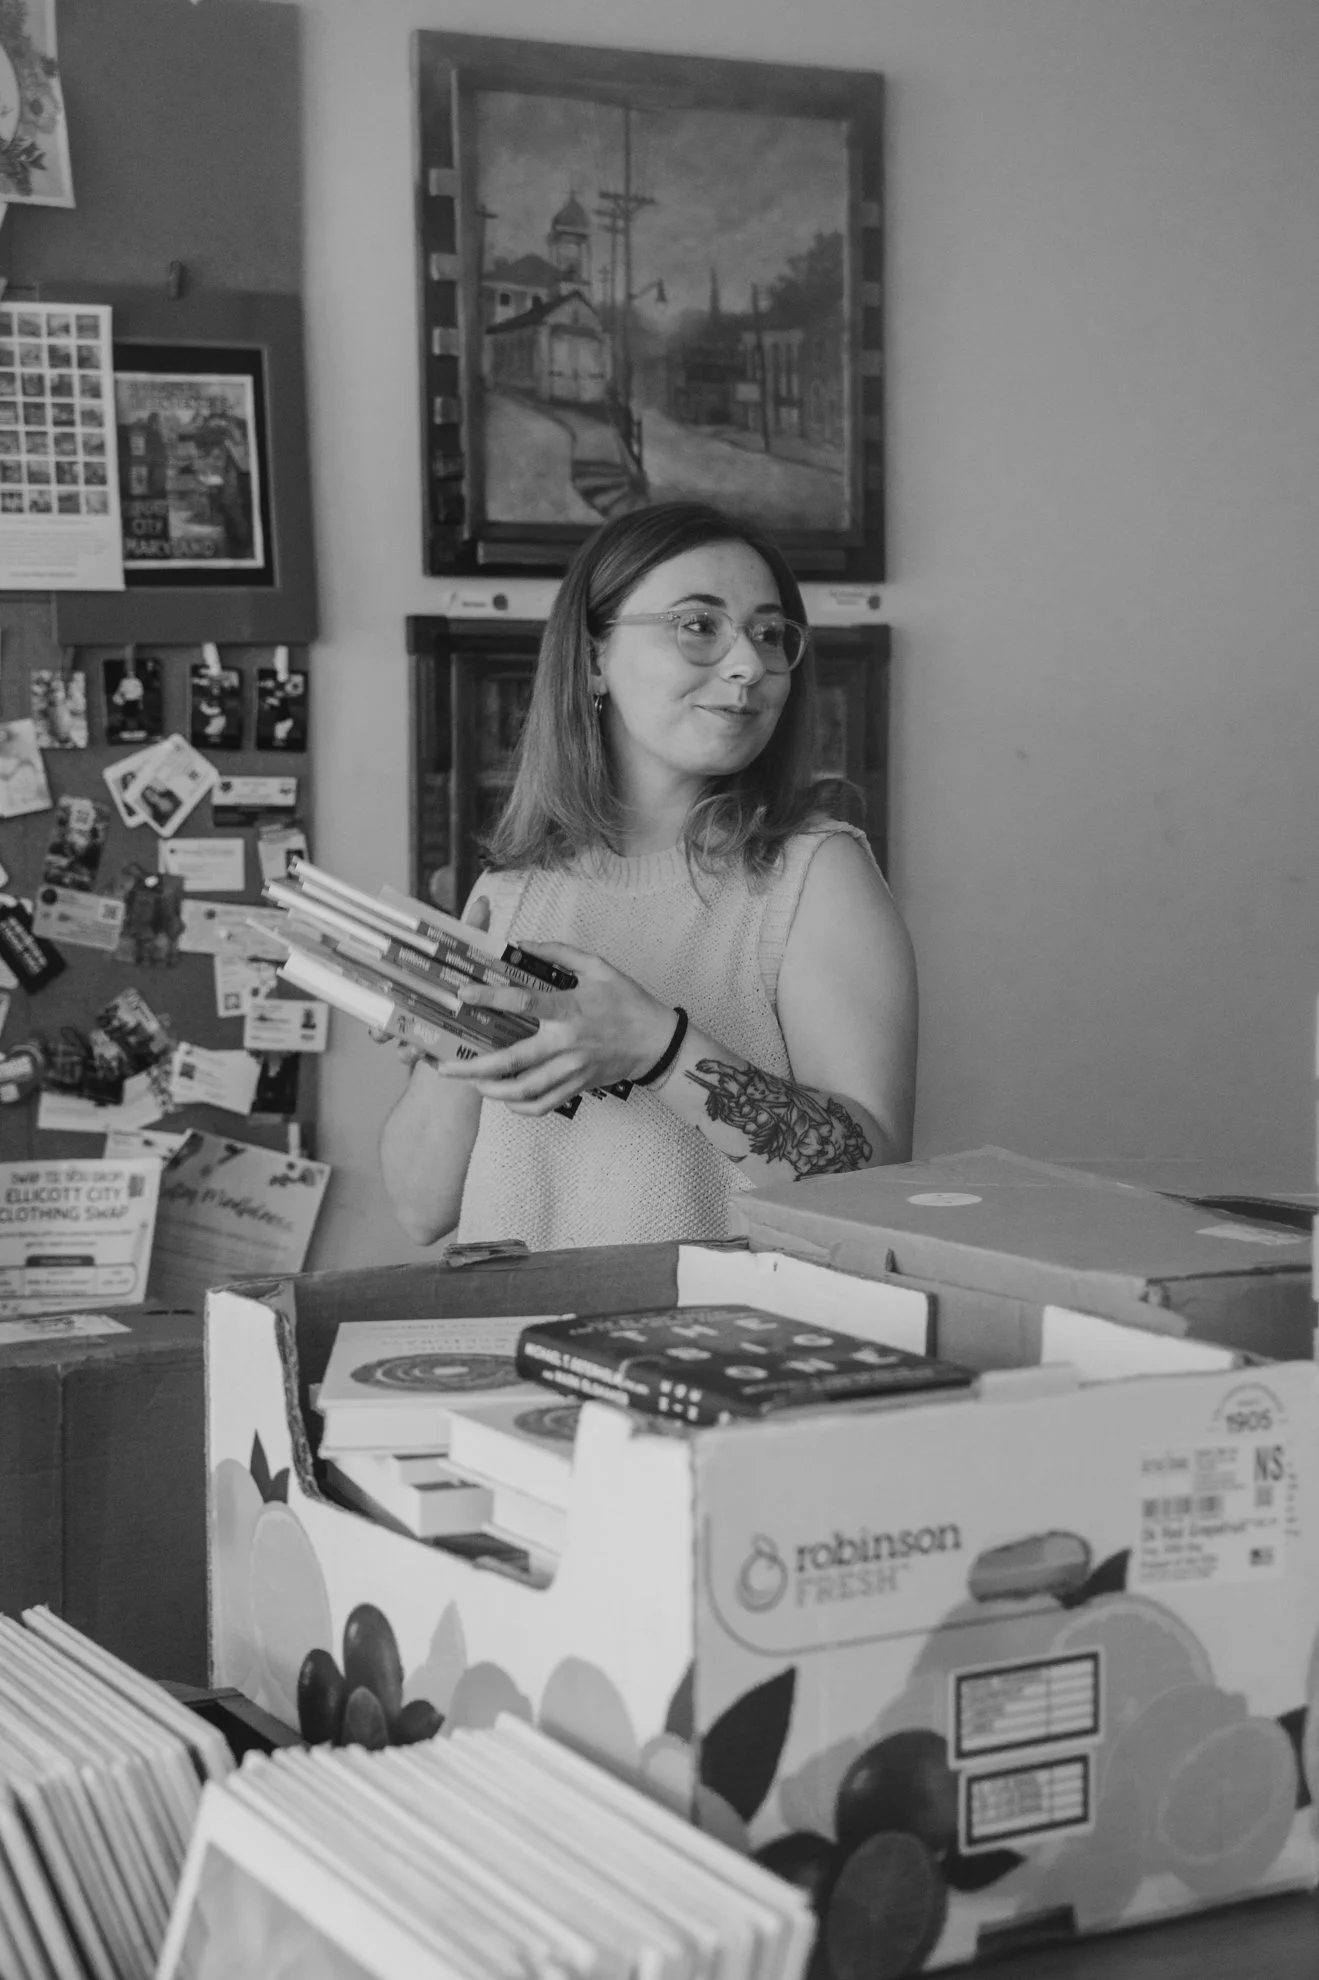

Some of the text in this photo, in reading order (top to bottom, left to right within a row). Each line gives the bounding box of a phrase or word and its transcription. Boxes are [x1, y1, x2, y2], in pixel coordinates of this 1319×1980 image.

[5, 1186, 122, 1203] ELLICOTT CITY
[0, 1205, 129, 1224] CLOTHING SWAP
[1226, 1409, 1273, 1434] 1905
[1253, 1444, 1284, 1482] NS
[797, 1522, 962, 1573] robinson
[796, 1564, 899, 1608] FRESH
